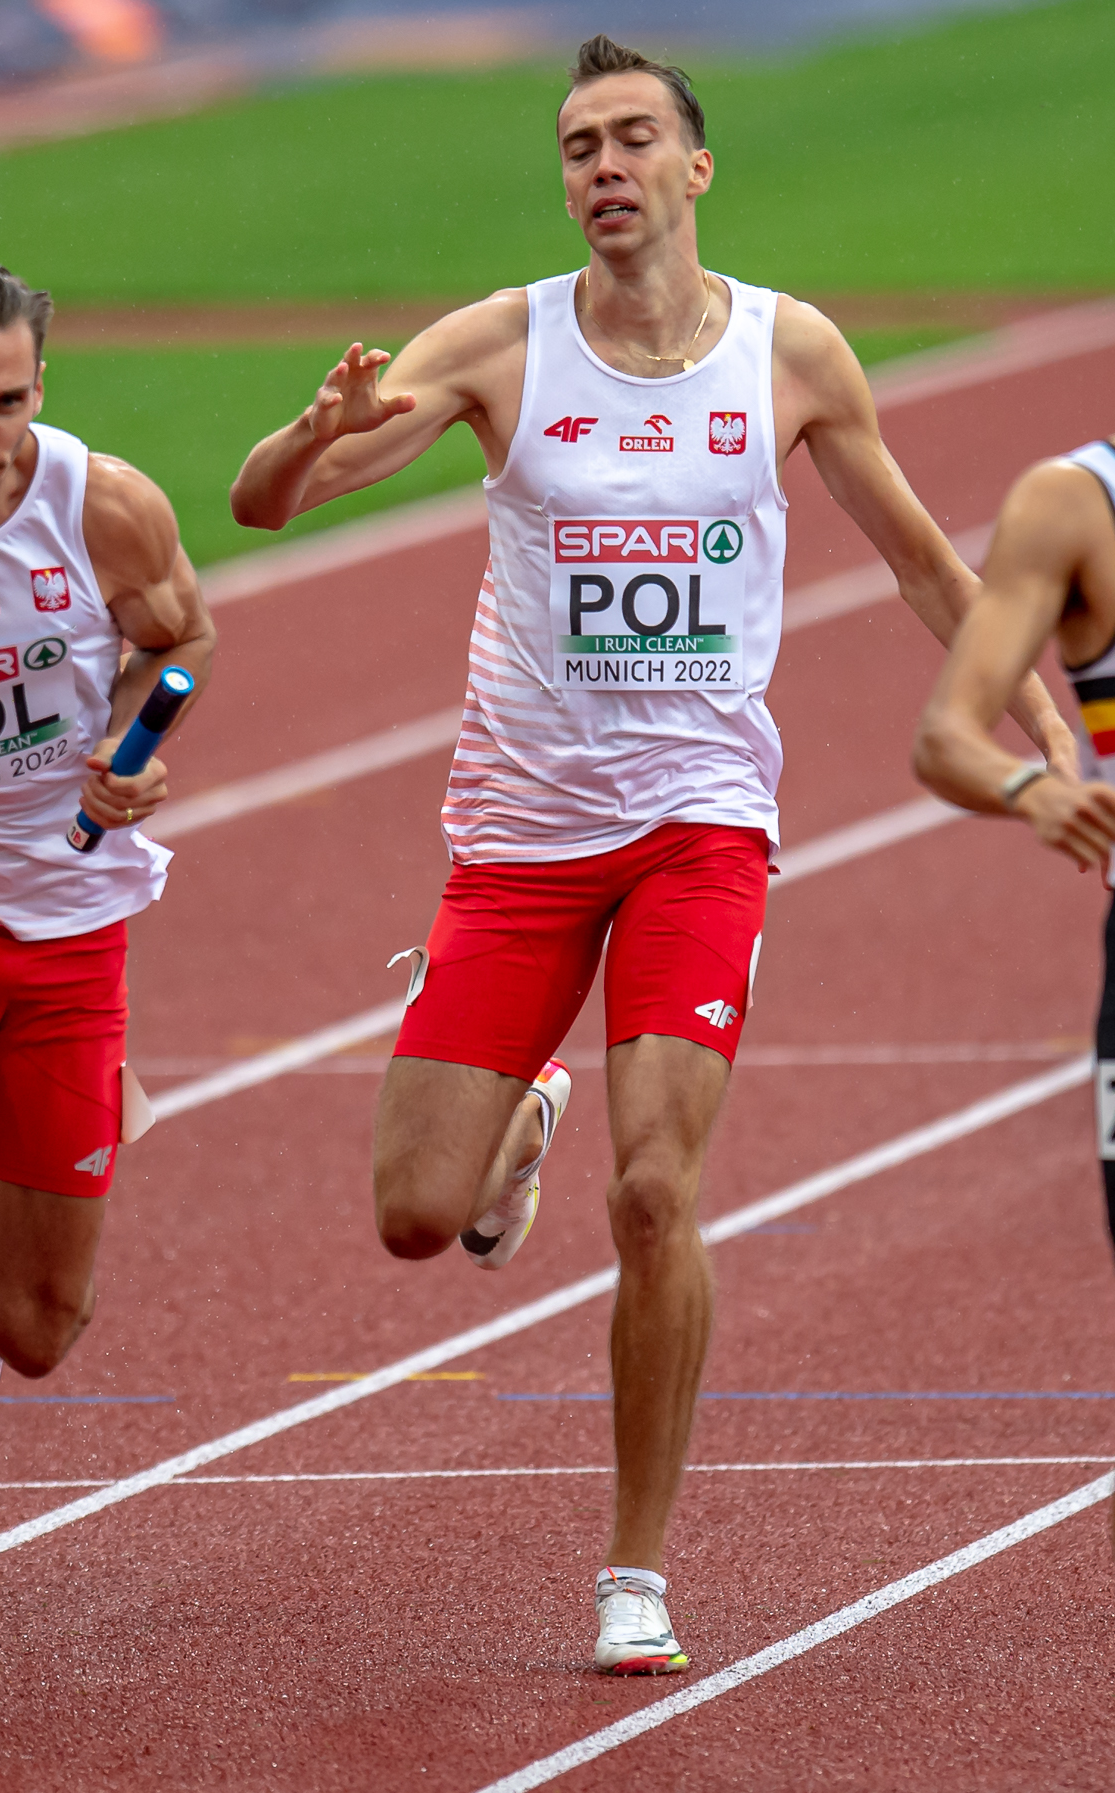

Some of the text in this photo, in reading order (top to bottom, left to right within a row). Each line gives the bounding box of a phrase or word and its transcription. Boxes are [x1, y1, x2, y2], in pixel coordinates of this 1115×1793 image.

[543, 415, 599, 443] 4F
[621, 437, 671, 451] ORLEN
[558, 525, 695, 557] SPAR
[569, 573, 726, 636] POL
[595, 637, 600, 651] I
[604, 637, 641, 652] RUN
[566, 659, 732, 682] MUNICH 2022
[10, 739, 68, 778] 2022
[694, 999, 738, 1030] 4F
